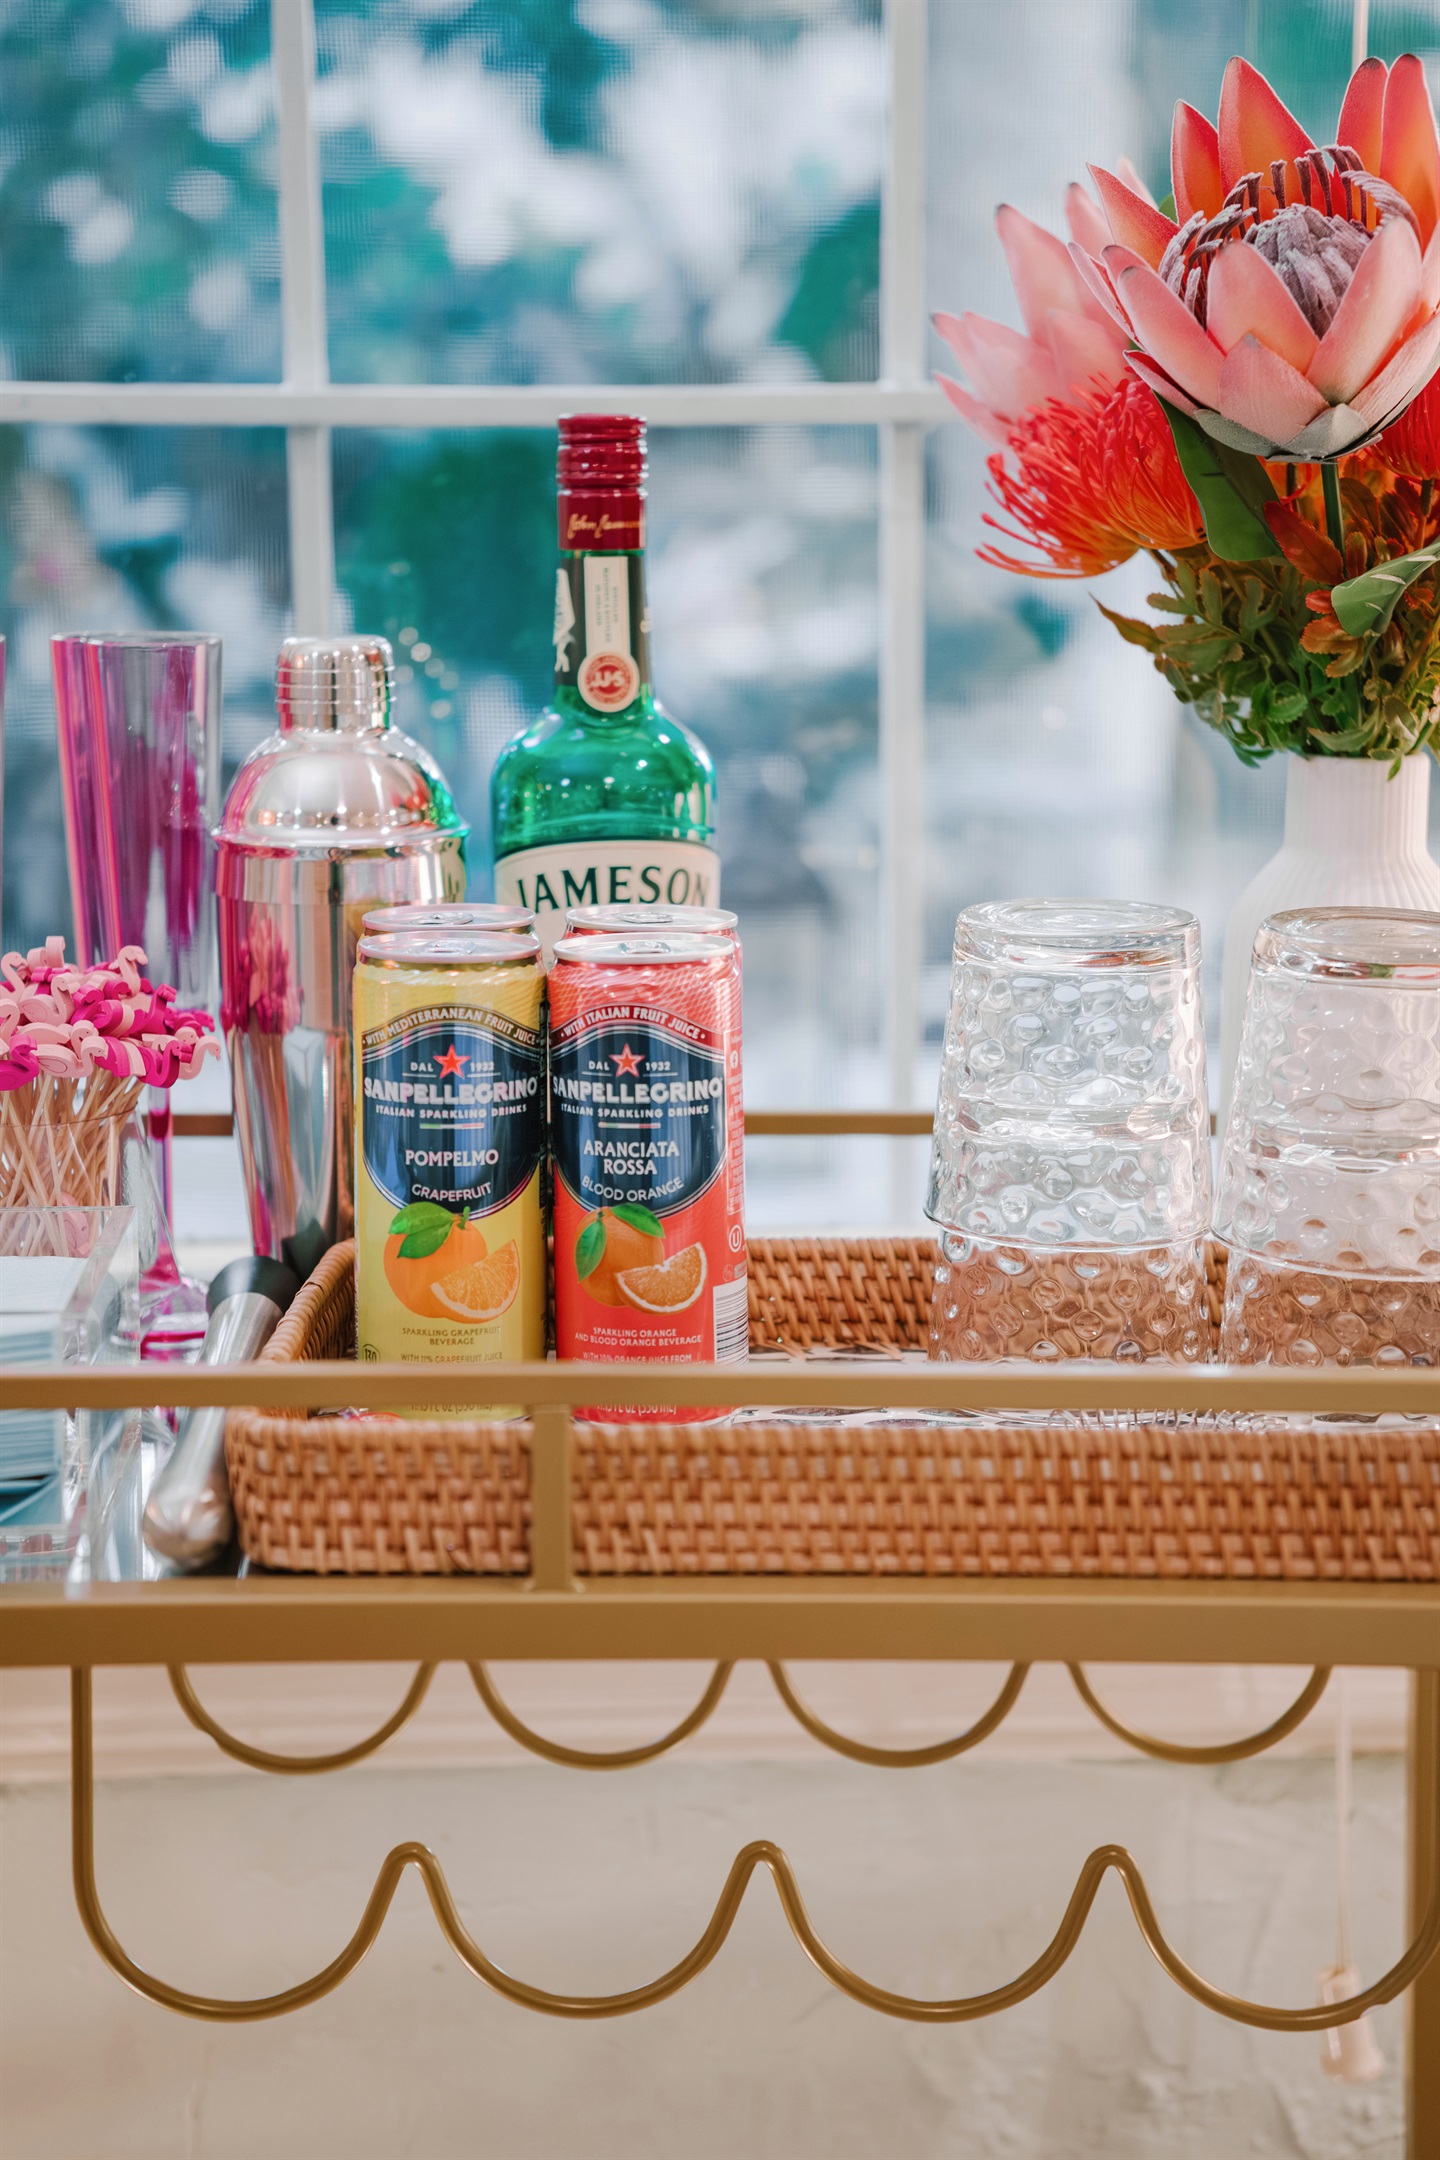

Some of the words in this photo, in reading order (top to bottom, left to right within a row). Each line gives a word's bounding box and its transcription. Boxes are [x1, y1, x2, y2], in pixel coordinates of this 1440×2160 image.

[517, 866, 710, 914] JAMESON
[366, 1027, 386, 1045] WITH
[387, 1007, 482, 1036] MEDITERRANEAN
[484, 1014, 514, 1034] FRUIT
[513, 1028, 536, 1045] JUICE
[564, 1018, 584, 1036] WITH
[586, 1006, 630, 1026] ITALIAN
[633, 1007, 668, 1025] FRUIT
[668, 1018, 700, 1039] JUICE
[410, 1062, 434, 1072] DAL
[470, 1061, 495, 1072] 1932
[588, 1061, 610, 1071] DAL
[646, 1061, 671, 1071] 1932
[364, 1077, 538, 1105] SANPELLEGRINO
[552, 1077, 723, 1104] SANPELLEGRINO
[376, 1105, 415, 1118] ITALIAN
[419, 1108, 487, 1119] SPARKLING
[491, 1104, 527, 1117] DRINKS
[561, 1103, 593, 1116] ITALIAN
[597, 1108, 664, 1118] SPARKLING
[668, 1104, 709, 1116] DRINKS
[583, 1139, 680, 1158] ARANCIATA
[405, 1149, 499, 1167] POMPELMO
[603, 1158, 657, 1175] ROSSA
[411, 1182, 492, 1202] GRAPEFRUIT
[581, 1176, 624, 1201] BLOOD
[626, 1176, 685, 1202] ORANGE
[402, 1327, 449, 1337] SPARKLING
[450, 1326, 501, 1337] GRAPEFRUIT
[575, 1332, 589, 1342] AND
[590, 1336, 617, 1346] BLOOD
[619, 1337, 656, 1347] ORANGE
[658, 1334, 703, 1346] BEVERAGE
[593, 1327, 638, 1338] SPARKLING
[639, 1328, 677, 1338] ORANGE
[429, 1337, 475, 1346] BEVERAGE
[401, 1353, 420, 1363] WITH
[435, 1353, 482, 1364] GRAPEFRUIT
[483, 1352, 503, 1362] JUICE
[582, 1351, 598, 1361] WITH
[614, 1354, 646, 1364] ORANGE
[648, 1354, 670, 1364] JUICE
[671, 1354, 692, 1363] FROM
